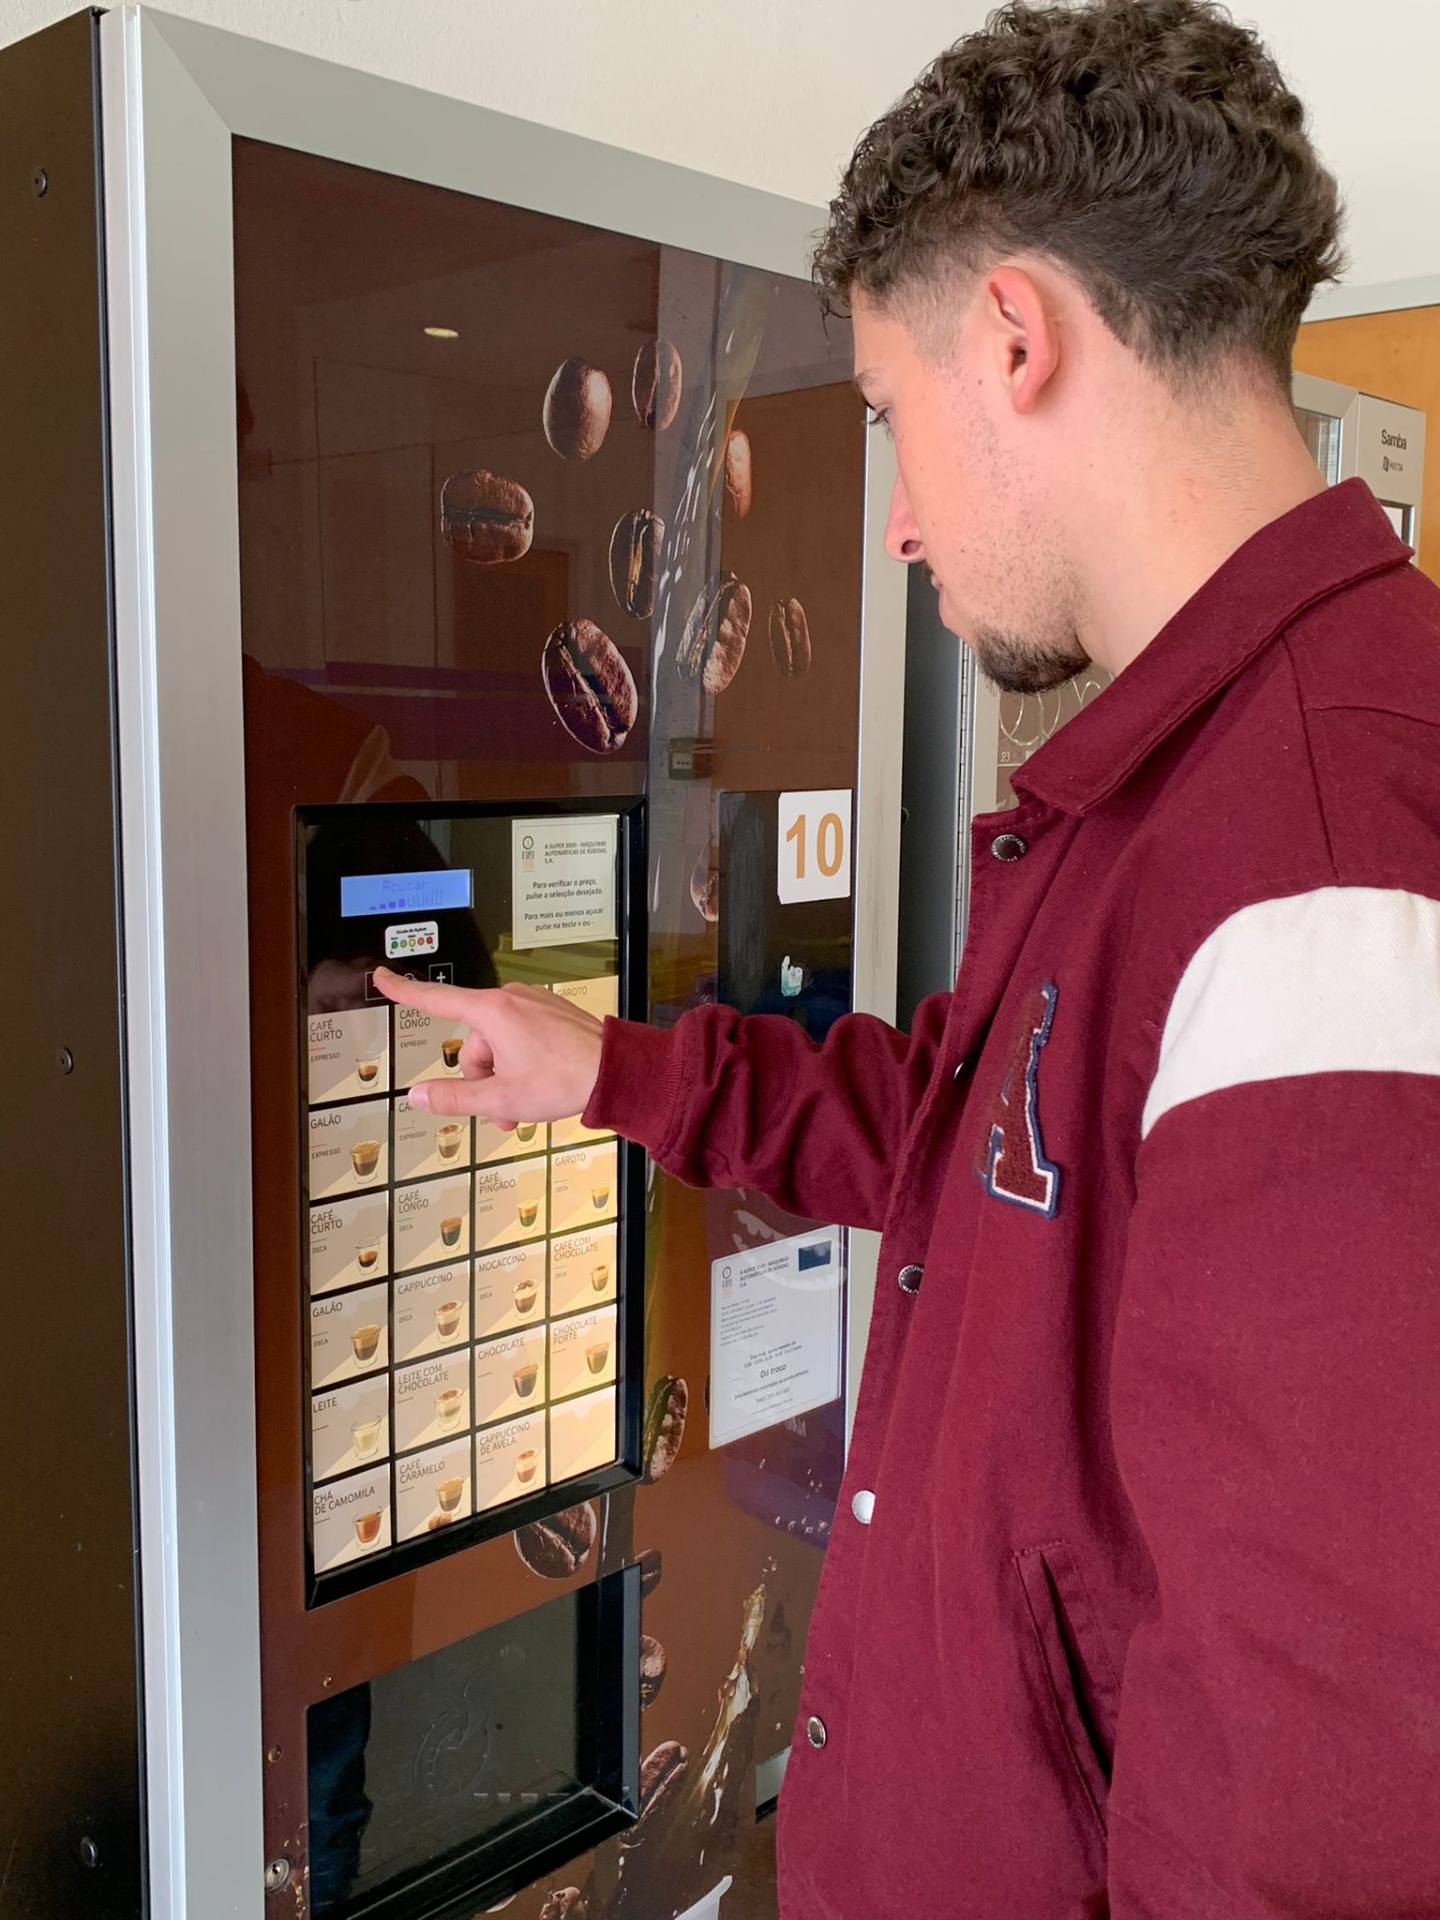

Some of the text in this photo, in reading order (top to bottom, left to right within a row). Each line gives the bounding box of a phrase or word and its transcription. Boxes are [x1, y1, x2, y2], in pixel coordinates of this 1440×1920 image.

[1381, 428, 1407, 450] Samba
[786, 813, 844, 879] 10
[548, 879, 573, 888] verificar
[526, 893, 543, 901] pulse
[549, 889, 575, 899] selecção
[525, 913, 538, 921] Para
[540, 911, 554, 919] mais
[536, 924, 552, 932] pulse
[562, 920, 577, 929] tecla
[557, 986, 588, 997] GAROTO
[310, 1019, 334, 1032] CAFÉ
[400, 1017, 431, 1030] LONGO
[310, 1029, 343, 1043] CURTO
[401, 1039, 428, 1048] EXPRESSO
[311, 1052, 341, 1062] EXPRESSO
[311, 1114, 342, 1129] GALÃO
[400, 1130, 427, 1141] EXPRESSO
[312, 1148, 341, 1159] EXPRESSO
[555, 1153, 587, 1167] GAROTO
[479, 1172, 500, 1186] CAFÉ
[479, 1179, 516, 1196] PINGADO
[556, 1185, 568, 1193] DECA
[398, 1190, 420, 1204] CAFÉ
[399, 1199, 429, 1215] LONGO
[480, 1204, 493, 1213] DECA
[311, 1210, 334, 1224] CAFÉ
[311, 1219, 343, 1236] CURTO
[400, 1223, 414, 1233] DECA
[313, 1245, 327, 1254] DECA
[554, 1236, 592, 1253] CAFÉ COM
[554, 1243, 599, 1262] CHOCOLATE
[479, 1253, 527, 1273] MOCACCINO
[555, 1271, 568, 1280] DECA
[398, 1272, 453, 1295] CAPPUCCINO
[480, 1291, 493, 1300] DECA
[312, 1301, 343, 1318] GALÃO
[399, 1314, 413, 1324] DECA
[553, 1316, 598, 1337] CHOCOLATE
[313, 1338, 329, 1348] DECA
[553, 1331, 578, 1346] FORTE
[478, 1337, 526, 1361] CHOCOLATE
[398, 1364, 443, 1386] LEITE COM
[398, 1371, 449, 1396] CHOCOLATE
[313, 1397, 338, 1414] LEITE
[480, 1422, 531, 1447] CAPPUCCINO
[481, 1445, 491, 1456] DE
[400, 1458, 422, 1476] CAFÉ
[400, 1461, 446, 1485] CARAMELO
[315, 1486, 376, 1516] DE CAMOMILA
